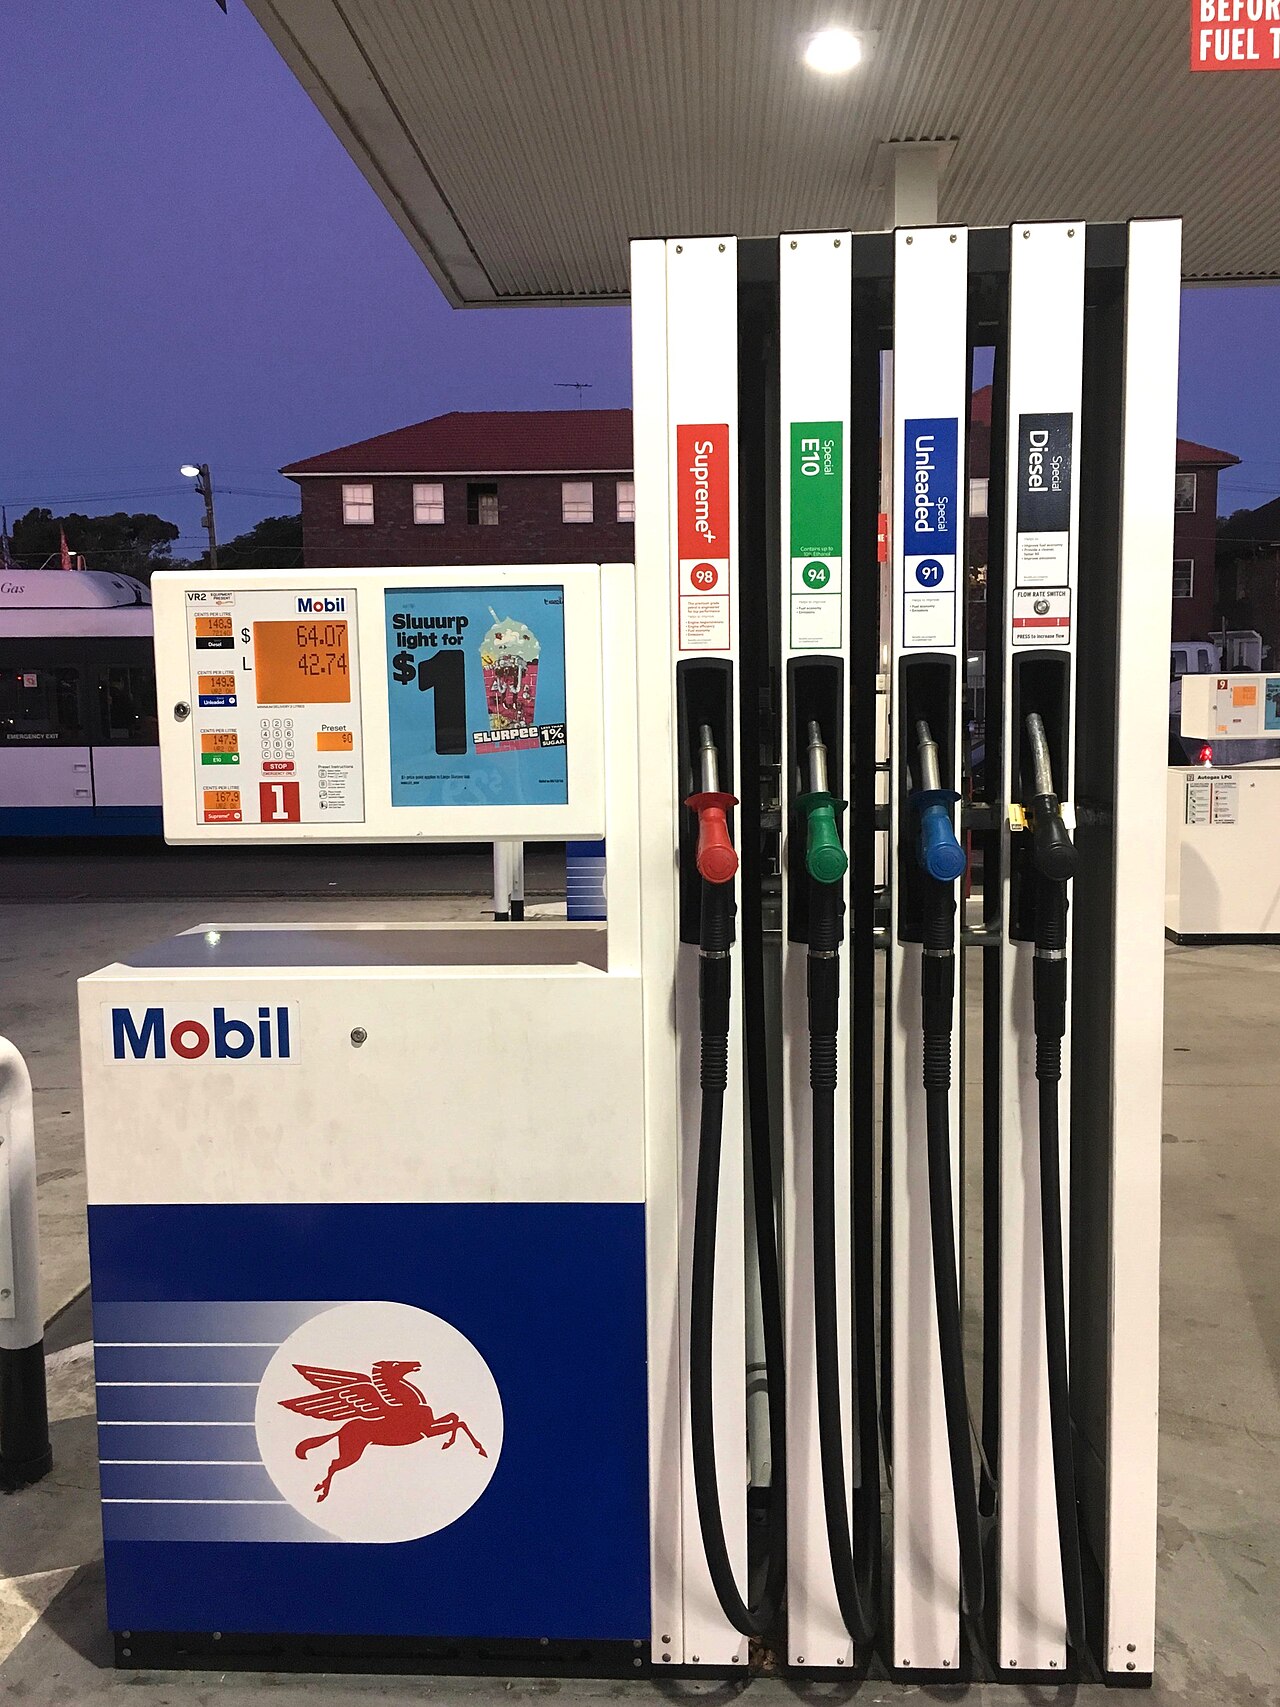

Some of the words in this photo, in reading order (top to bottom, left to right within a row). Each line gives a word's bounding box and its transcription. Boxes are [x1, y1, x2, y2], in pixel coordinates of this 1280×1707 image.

[1199, 28, 1260, 61] FUEL
[801, 438, 820, 476] E10
[821, 439, 834, 475] Special
[1028, 430, 1049, 492] Diesel
[1050, 455, 1063, 492] Special
[914, 435, 935, 532] Unleaded
[935, 496, 948, 532] Special
[695, 570, 713, 583] 98
[807, 569, 826, 582] 94
[921, 566, 938, 580] 91
[0, 582, 25, 594] Gas
[187, 593, 207, 601] VR2
[297, 597, 345, 612] Mobil
[209, 618, 232, 629] 148.9
[392, 613, 469, 635] Sluuurp
[241, 627, 251, 644] $
[297, 625, 346, 647] 64.07
[396, 632, 438, 650] light
[441, 633, 464, 646] for
[242, 656, 252, 671] L
[298, 653, 347, 675] 42.74
[211, 677, 235, 687] 149.9
[1220, 680, 1226, 689] 9
[392, 649, 467, 755] $1
[321, 724, 347, 732] Preset
[473, 727, 539, 743] SLURPEE
[541, 727, 564, 741] 1%
[213, 734, 238, 745] 147.9
[341, 732, 352, 743] $0
[542, 738, 565, 746] SUGAR
[216, 791, 239, 802] 167.9
[271, 784, 289, 819] 1
[112, 1007, 290, 1059] Mobil
